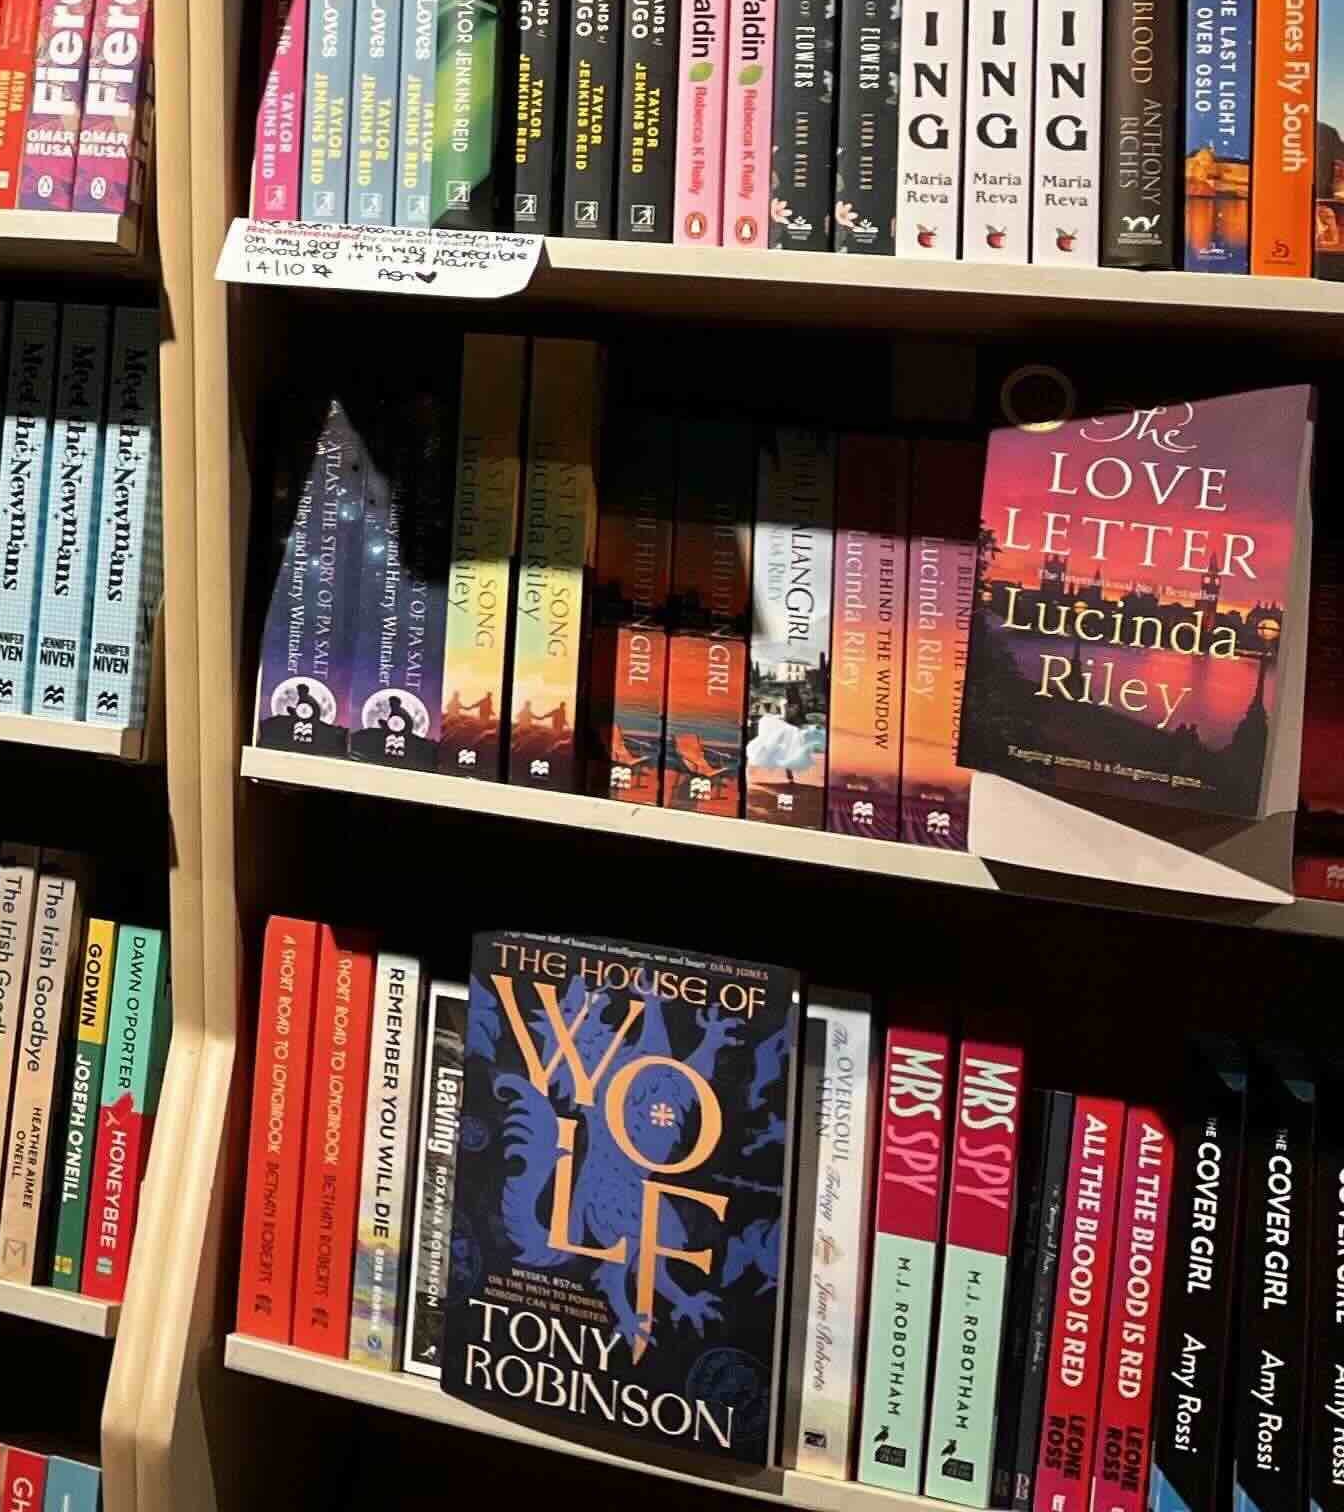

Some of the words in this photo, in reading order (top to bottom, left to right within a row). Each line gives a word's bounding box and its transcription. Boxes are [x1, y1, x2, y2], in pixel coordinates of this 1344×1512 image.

[1277, 60, 1310, 93] Fly
[26, 144, 72, 158] MUSA
[27, 129, 75, 144] OMAR
[1282, 103, 1309, 172] South
[277, 238, 300, 250] my
[307, 239, 340, 252] god
[352, 241, 382, 253] this
[392, 244, 424, 256] was
[1080, 403, 1197, 452] The
[1048, 452, 1227, 511] LOVE
[1004, 508, 1257, 578] LETTER
[1003, 587, 1239, 660] Lucinda
[1035, 654, 1192, 728] Riley
[491, 943, 566, 978] THE
[581, 957, 708, 1005] HOUSE
[720, 983, 767, 1020] OF
[888, 1046, 945, 1122] MRS
[884, 1125, 941, 1197] SPY
[469, 1299, 623, 1371] TONY
[464, 1345, 734, 1448] ROBINSON
